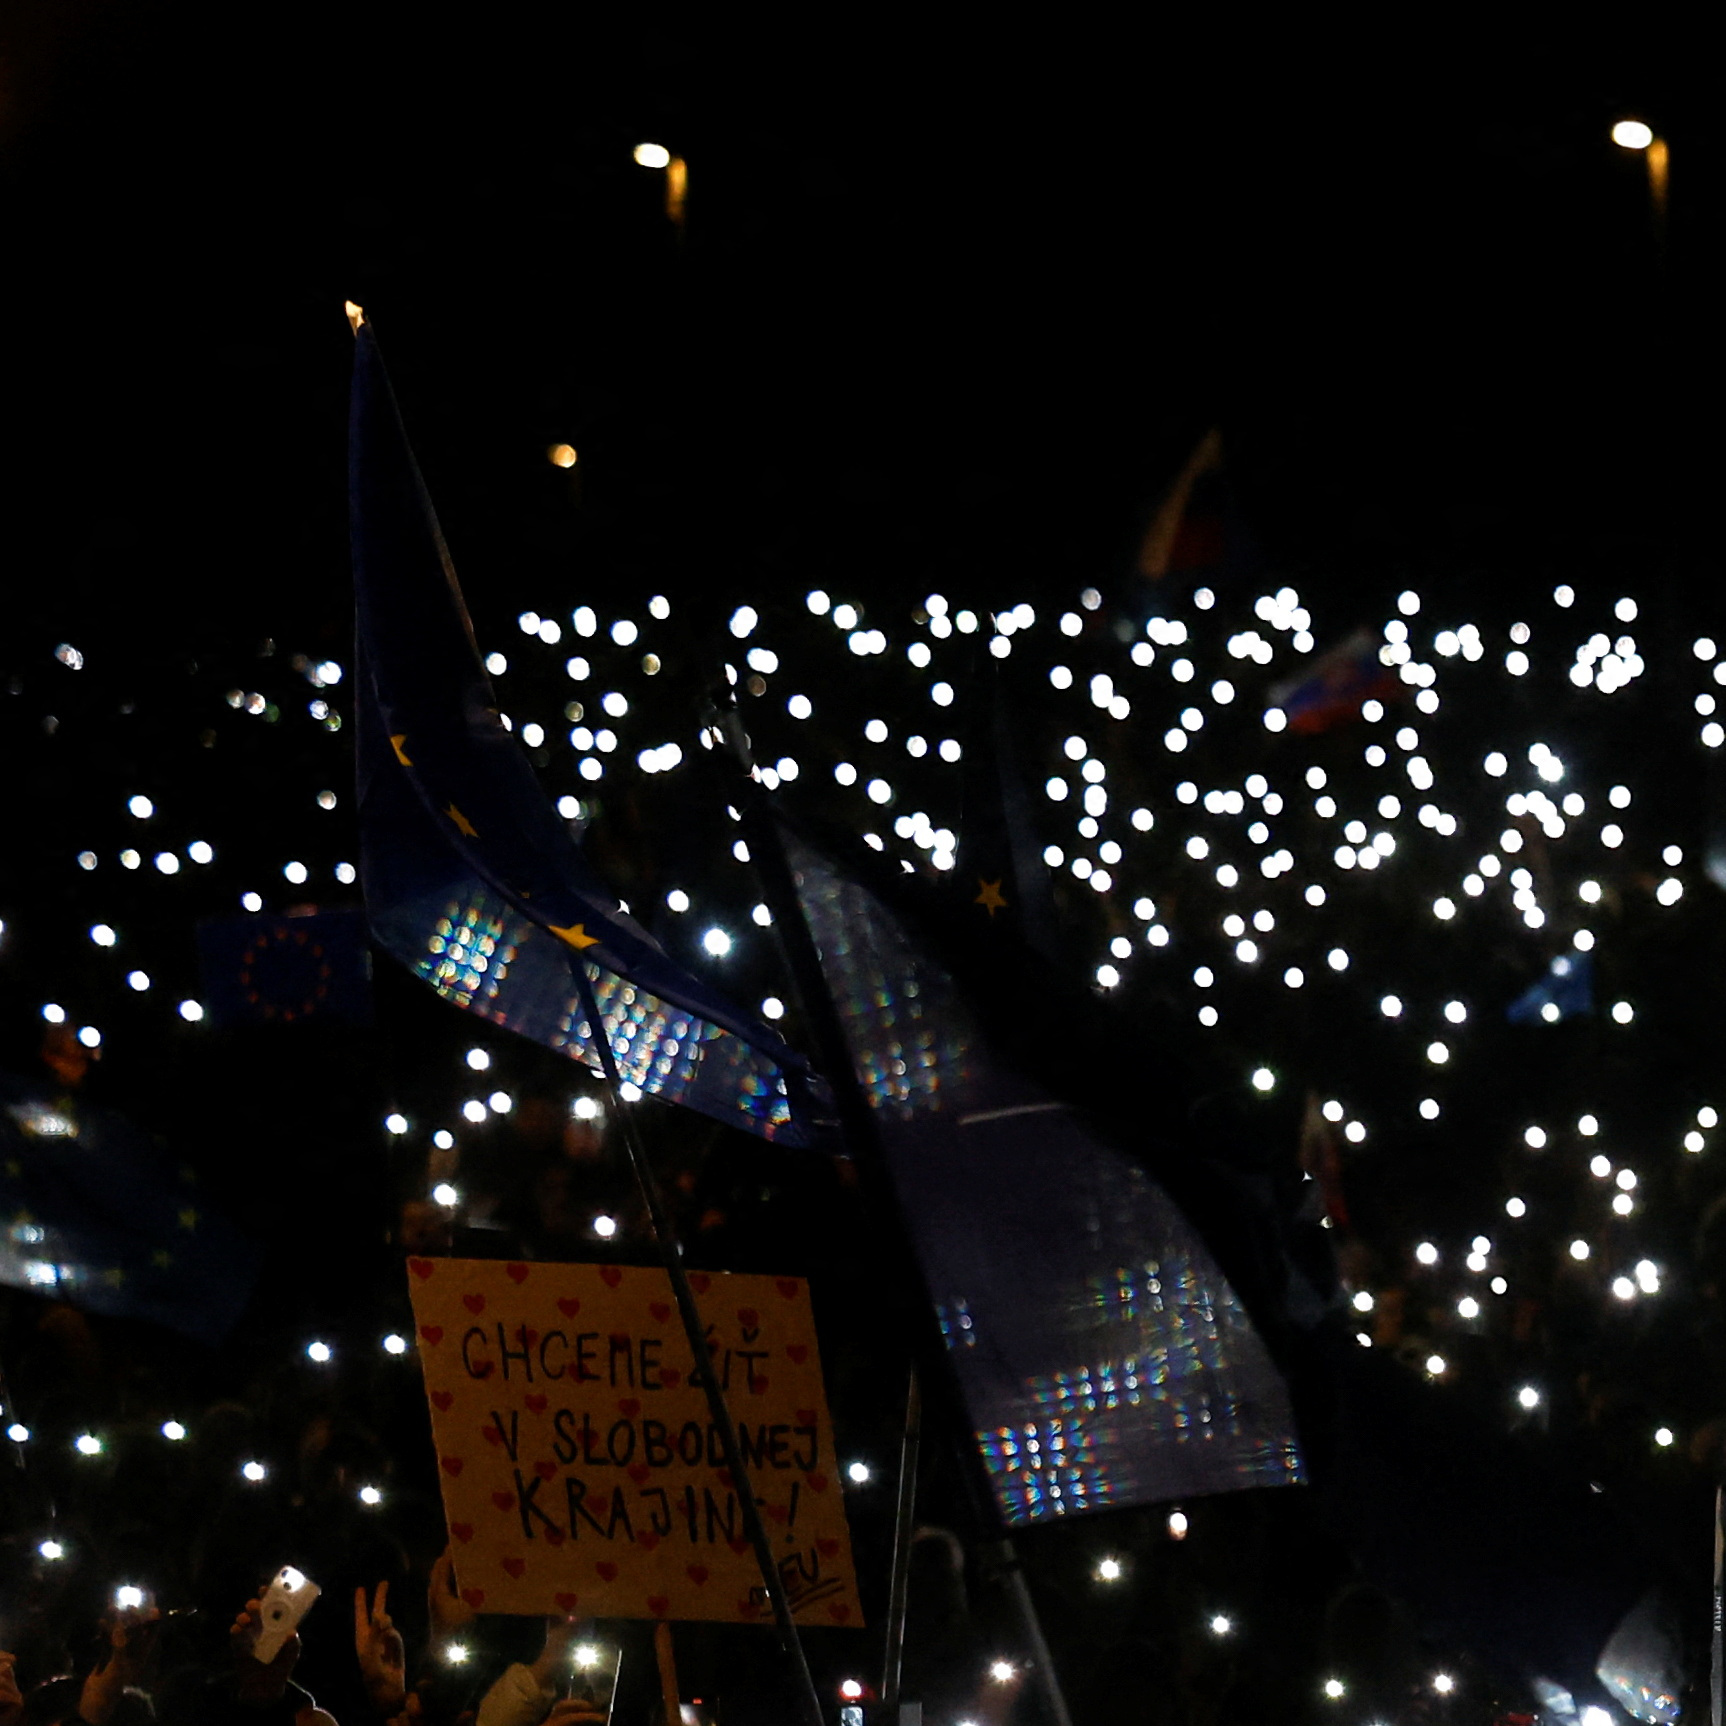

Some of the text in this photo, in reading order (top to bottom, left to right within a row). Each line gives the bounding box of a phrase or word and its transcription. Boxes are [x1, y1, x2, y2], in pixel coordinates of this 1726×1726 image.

[460, 1322, 664, 1392] CHCEME
[490, 1407, 820, 1473] V SLOBODNEJ
